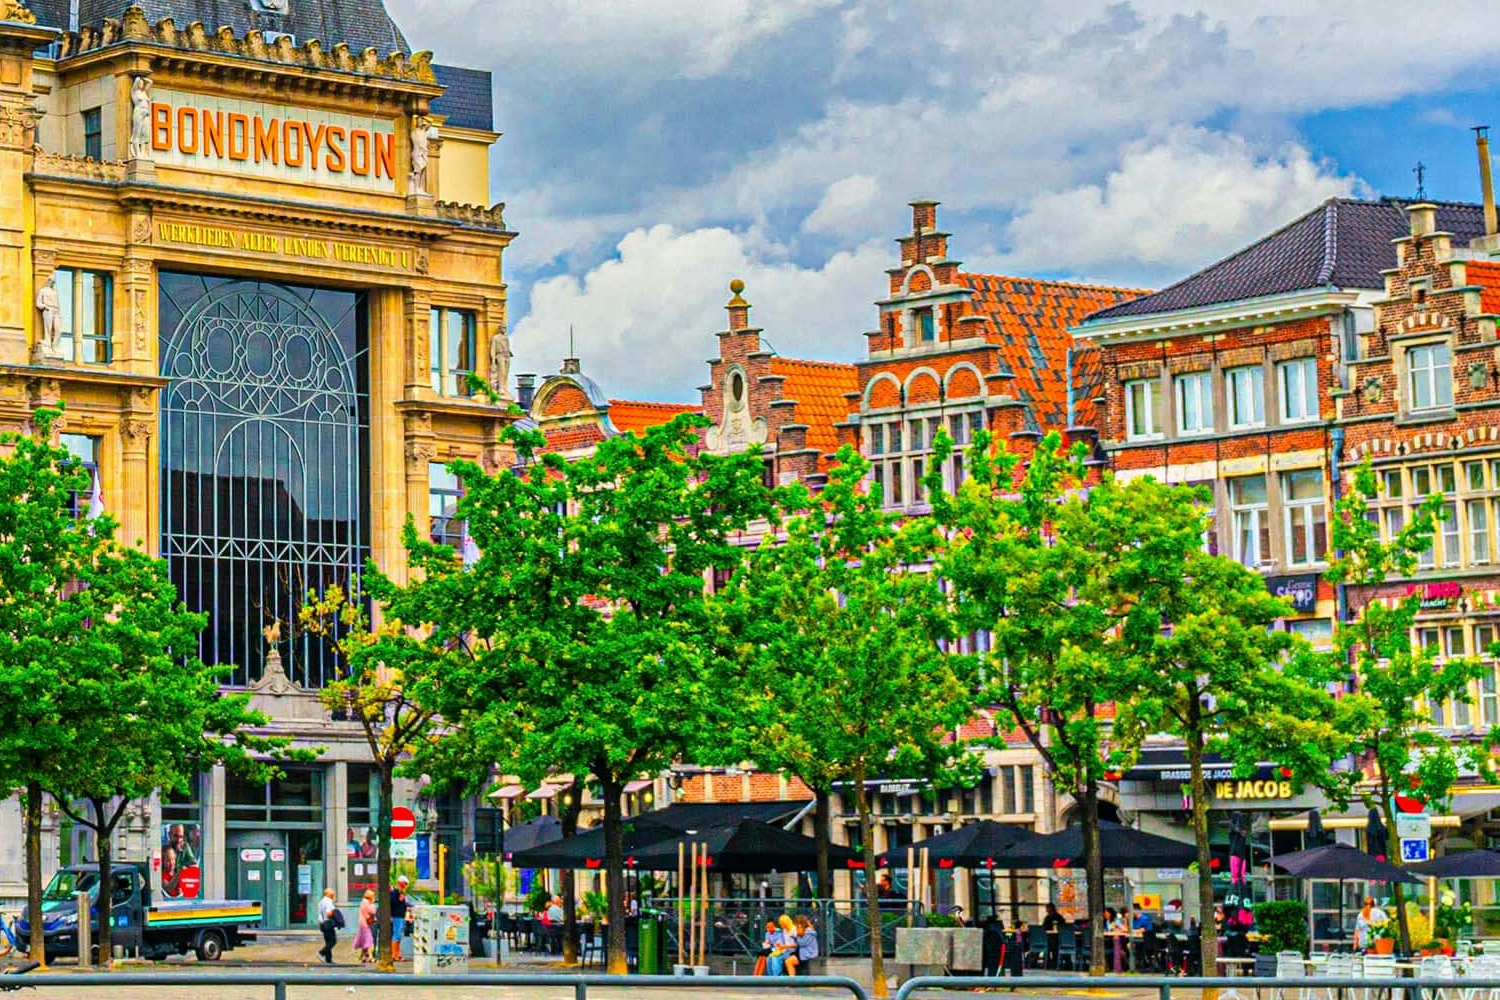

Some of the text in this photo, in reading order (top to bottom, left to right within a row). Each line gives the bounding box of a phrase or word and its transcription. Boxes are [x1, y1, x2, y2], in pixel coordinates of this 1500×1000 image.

[150, 101, 397, 180] BONDMOYSON
[158, 222, 237, 249] WERKLIEDEN
[241, 228, 278, 255] ALLER
[283, 237, 330, 259] LANDEN
[1160, 769, 1192, 780] BRASSE
[1216, 780, 1292, 799] DE JACOB
